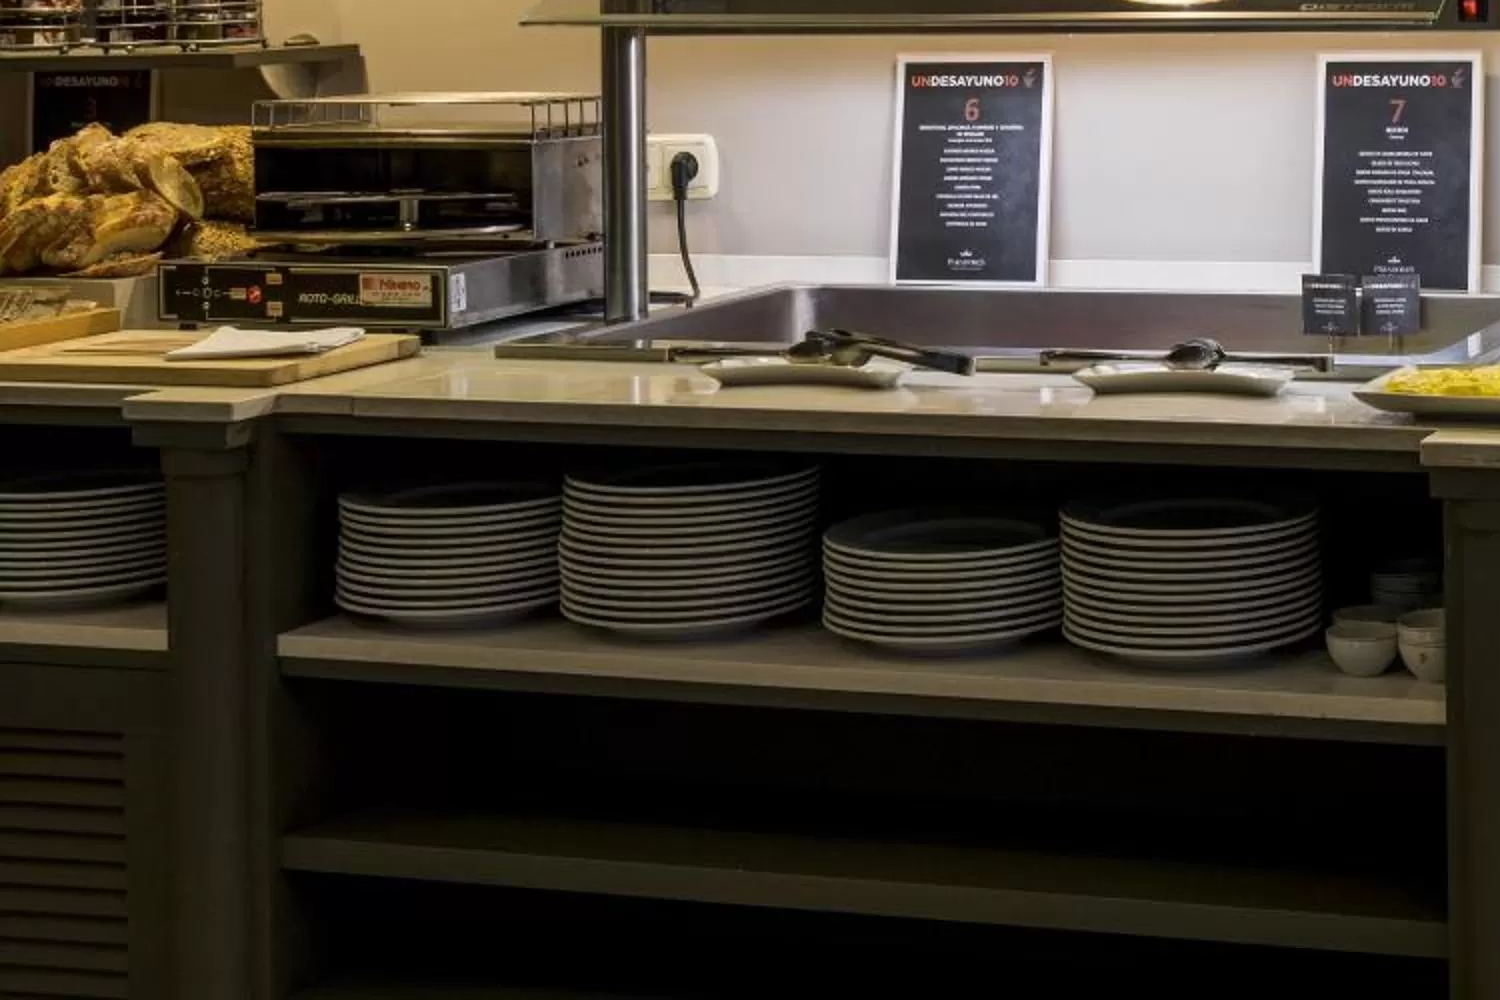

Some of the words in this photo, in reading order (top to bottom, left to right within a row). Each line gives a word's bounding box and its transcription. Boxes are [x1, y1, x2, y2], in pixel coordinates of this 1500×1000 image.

[911, 74, 1020, 88] UNDESAYUNO10
[1332, 74, 1447, 88] UNDESAYUNO10
[964, 98, 980, 121] 6
[1389, 99, 1407, 124] 7
